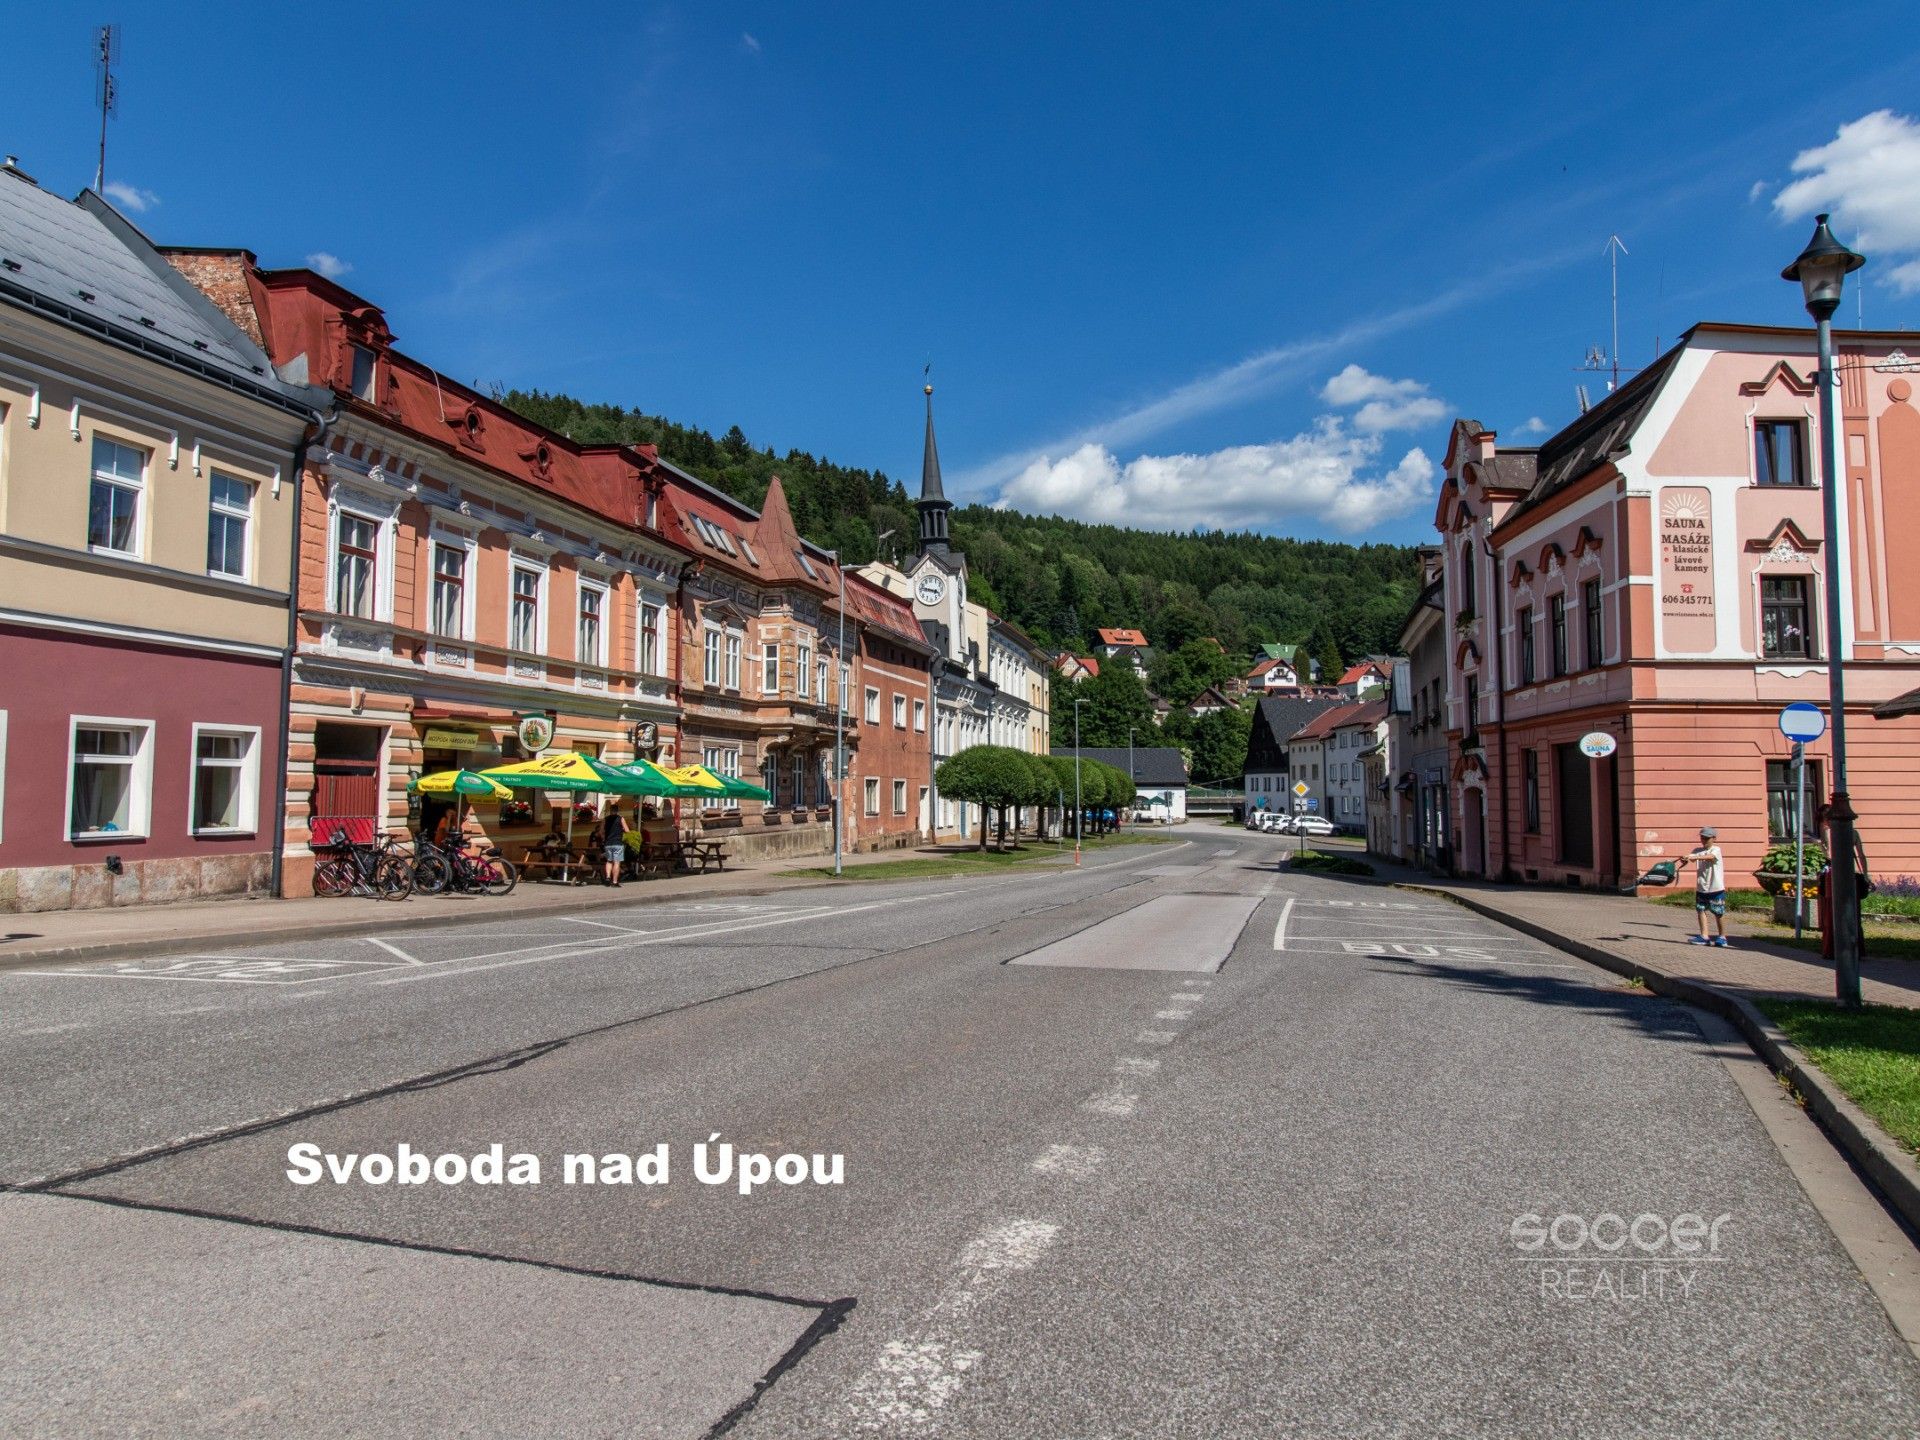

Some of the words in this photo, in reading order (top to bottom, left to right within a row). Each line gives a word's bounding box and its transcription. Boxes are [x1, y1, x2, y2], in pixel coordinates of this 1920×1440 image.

[1664, 518, 1705, 528] SAUNA
[1661, 532, 1710, 544] MASÁŽE
[1672, 545, 1709, 553] klasické
[1674, 555, 1703, 564] lávové
[1674, 564, 1709, 573] kameny
[1662, 595, 1679, 604] 606
[1679, 596, 1696, 604] 345
[1696, 596, 1713, 605] 771
[1341, 942, 1498, 960] BUS
